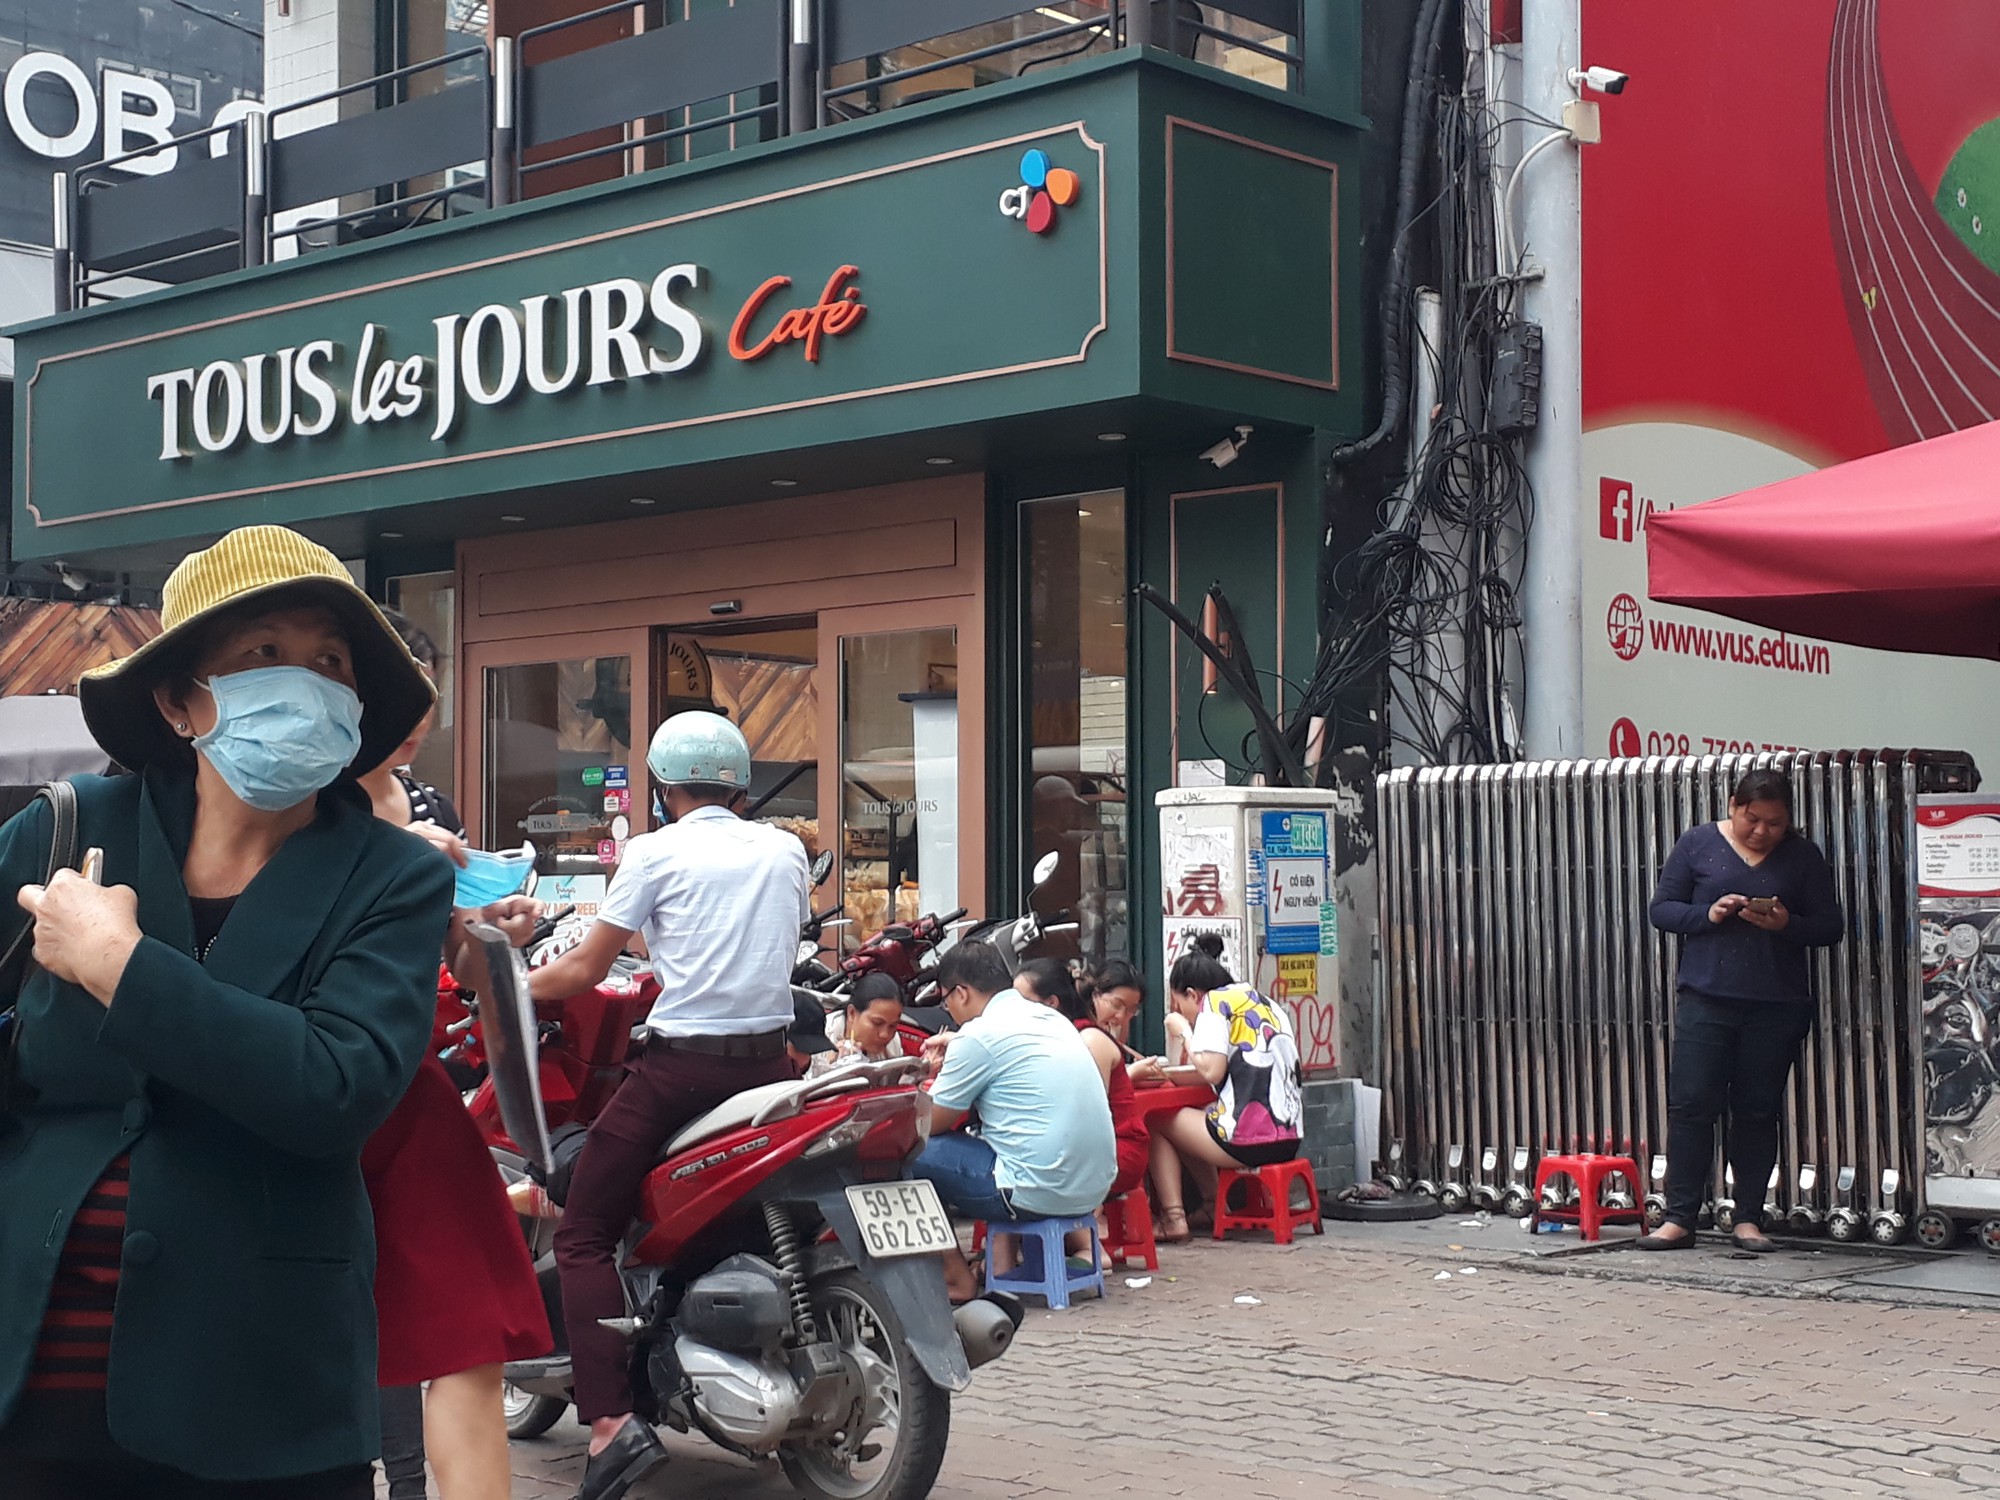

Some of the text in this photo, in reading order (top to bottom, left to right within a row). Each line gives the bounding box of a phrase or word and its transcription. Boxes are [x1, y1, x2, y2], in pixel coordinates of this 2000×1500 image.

[999, 185, 1029, 219] CJ
[147, 264, 867, 461] TOUS les JOURS Café
[1648, 618, 1831, 675] www.vus.edu.vn
[669, 642, 699, 691] JOURS
[863, 800, 892, 815] TOUS
[1289, 873, 1299, 888] CÓ
[1284, 895, 1301, 908] NGUY
[862, 1187, 926, 1218] 59-E1
[867, 1216, 948, 1251] 662.65
